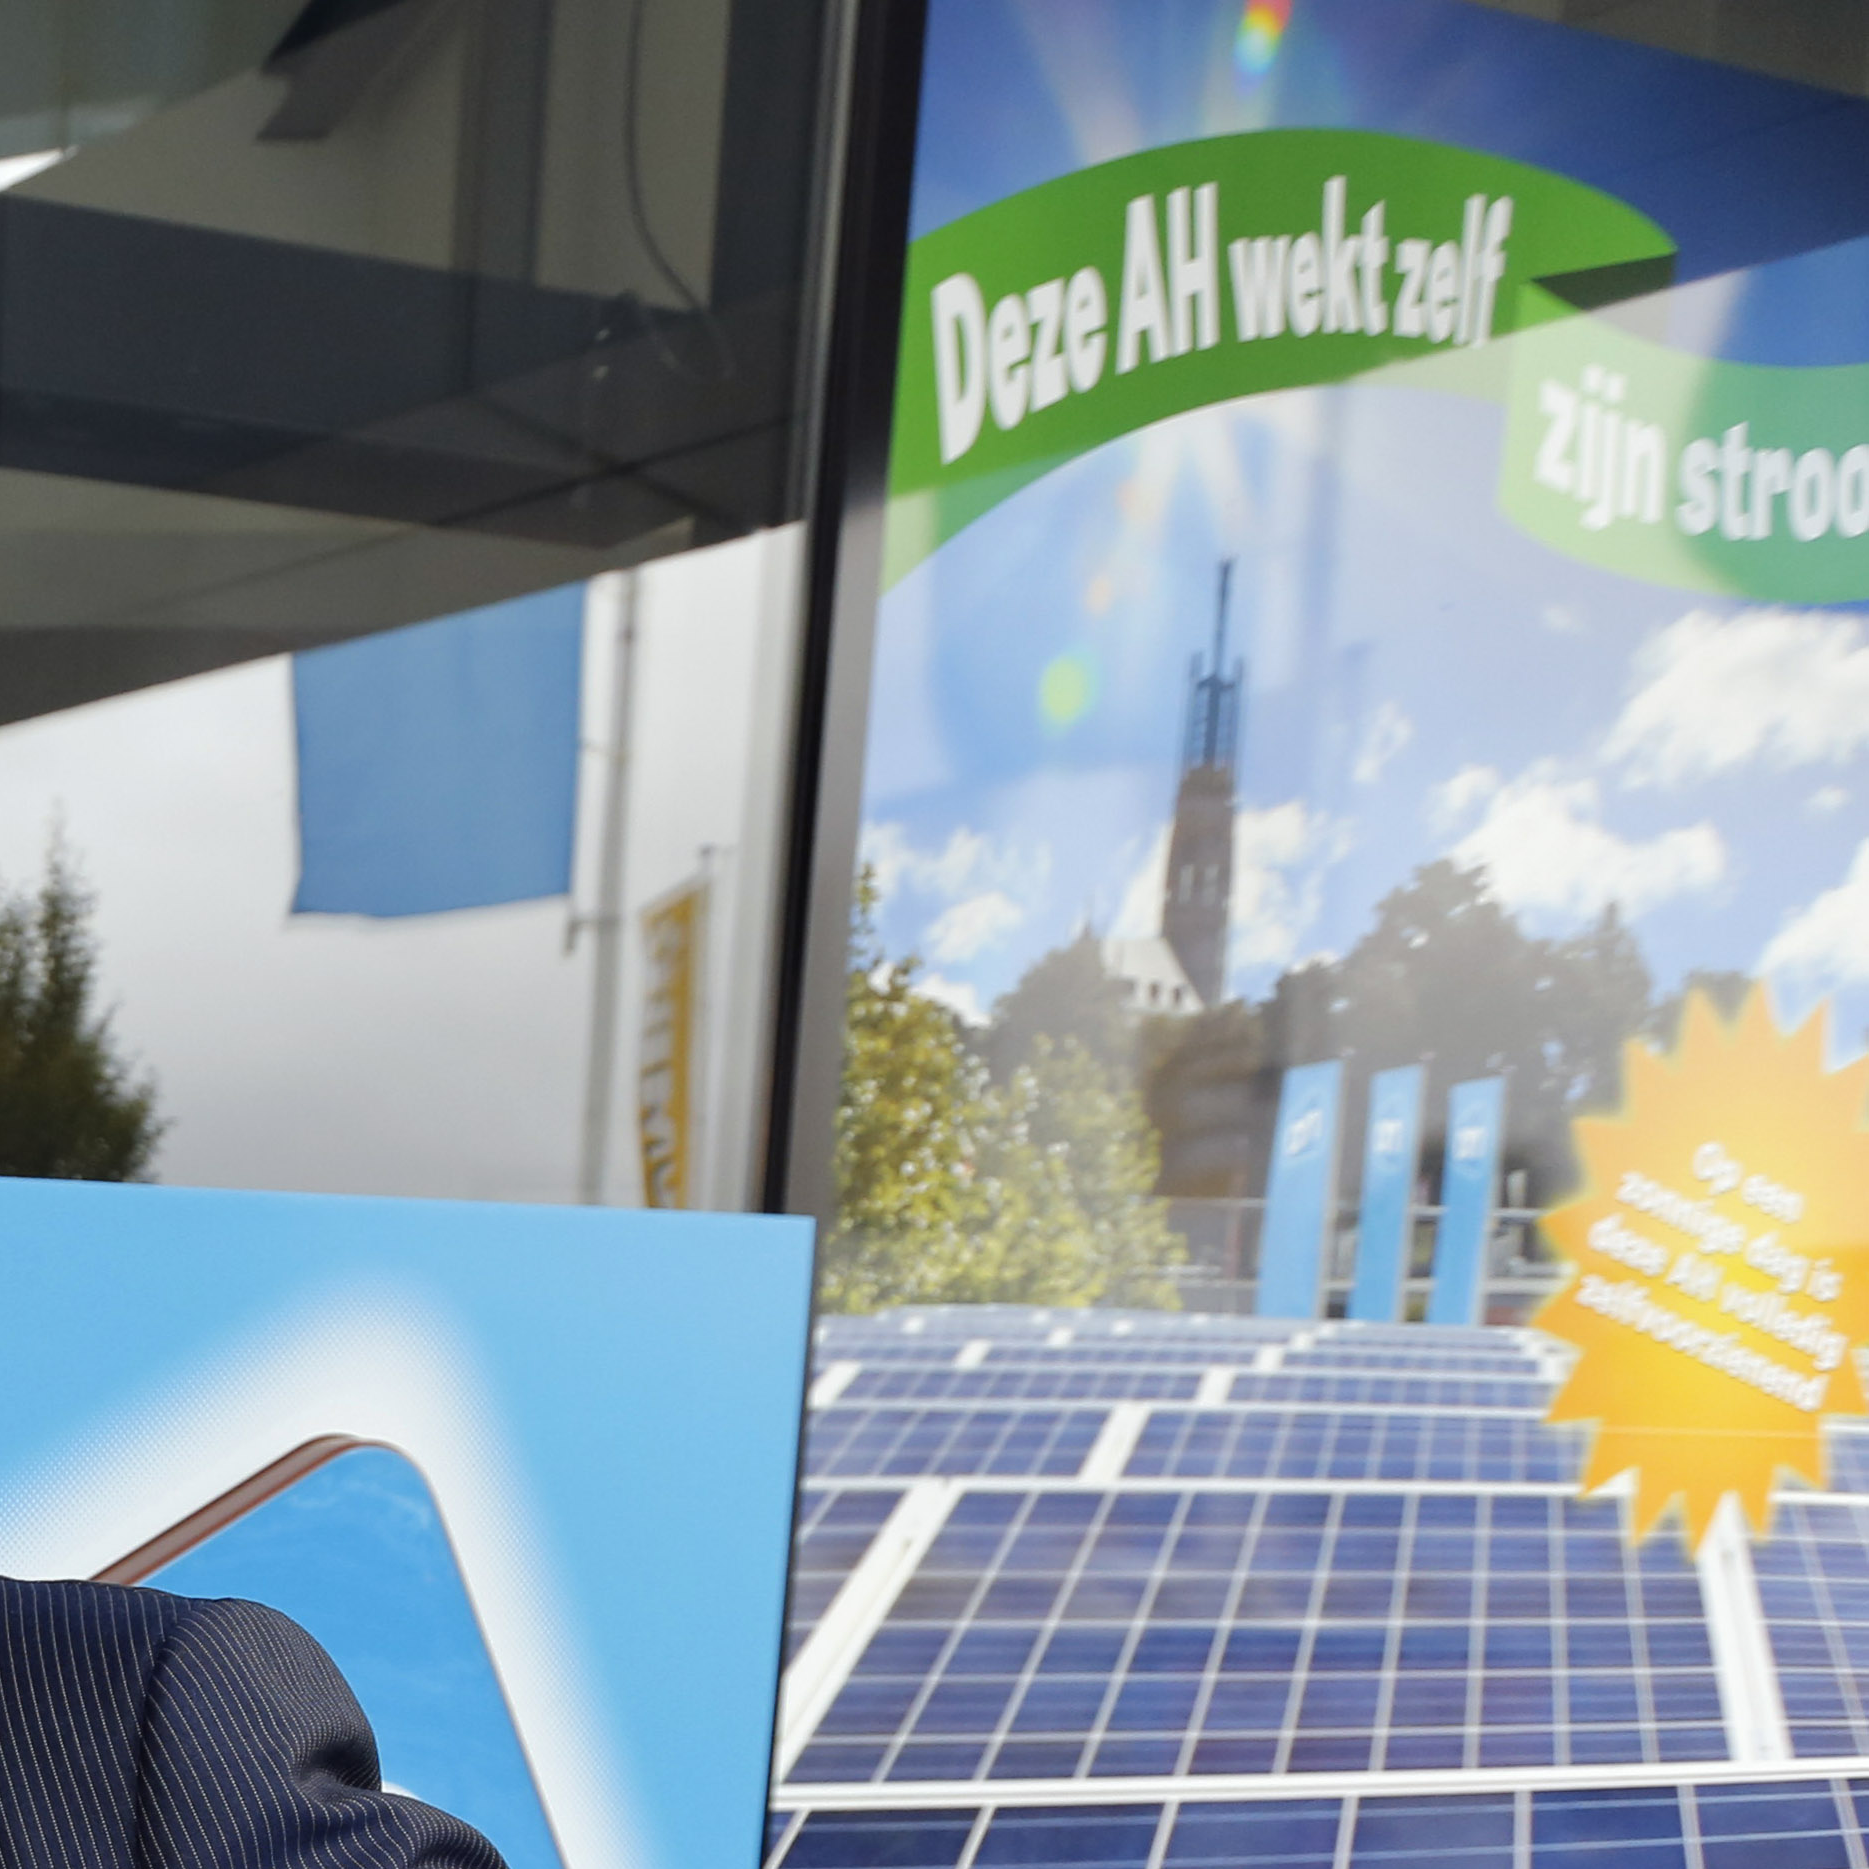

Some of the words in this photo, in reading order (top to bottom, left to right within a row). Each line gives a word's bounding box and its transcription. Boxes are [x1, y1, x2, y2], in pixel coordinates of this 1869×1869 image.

[932, 266, 1107, 464] Deze
[1116, 182, 1219, 375] AH
[1229, 175, 1389, 342] wekt
[1394, 193, 1514, 347] zelf
[1534, 364, 1665, 531] zijn
